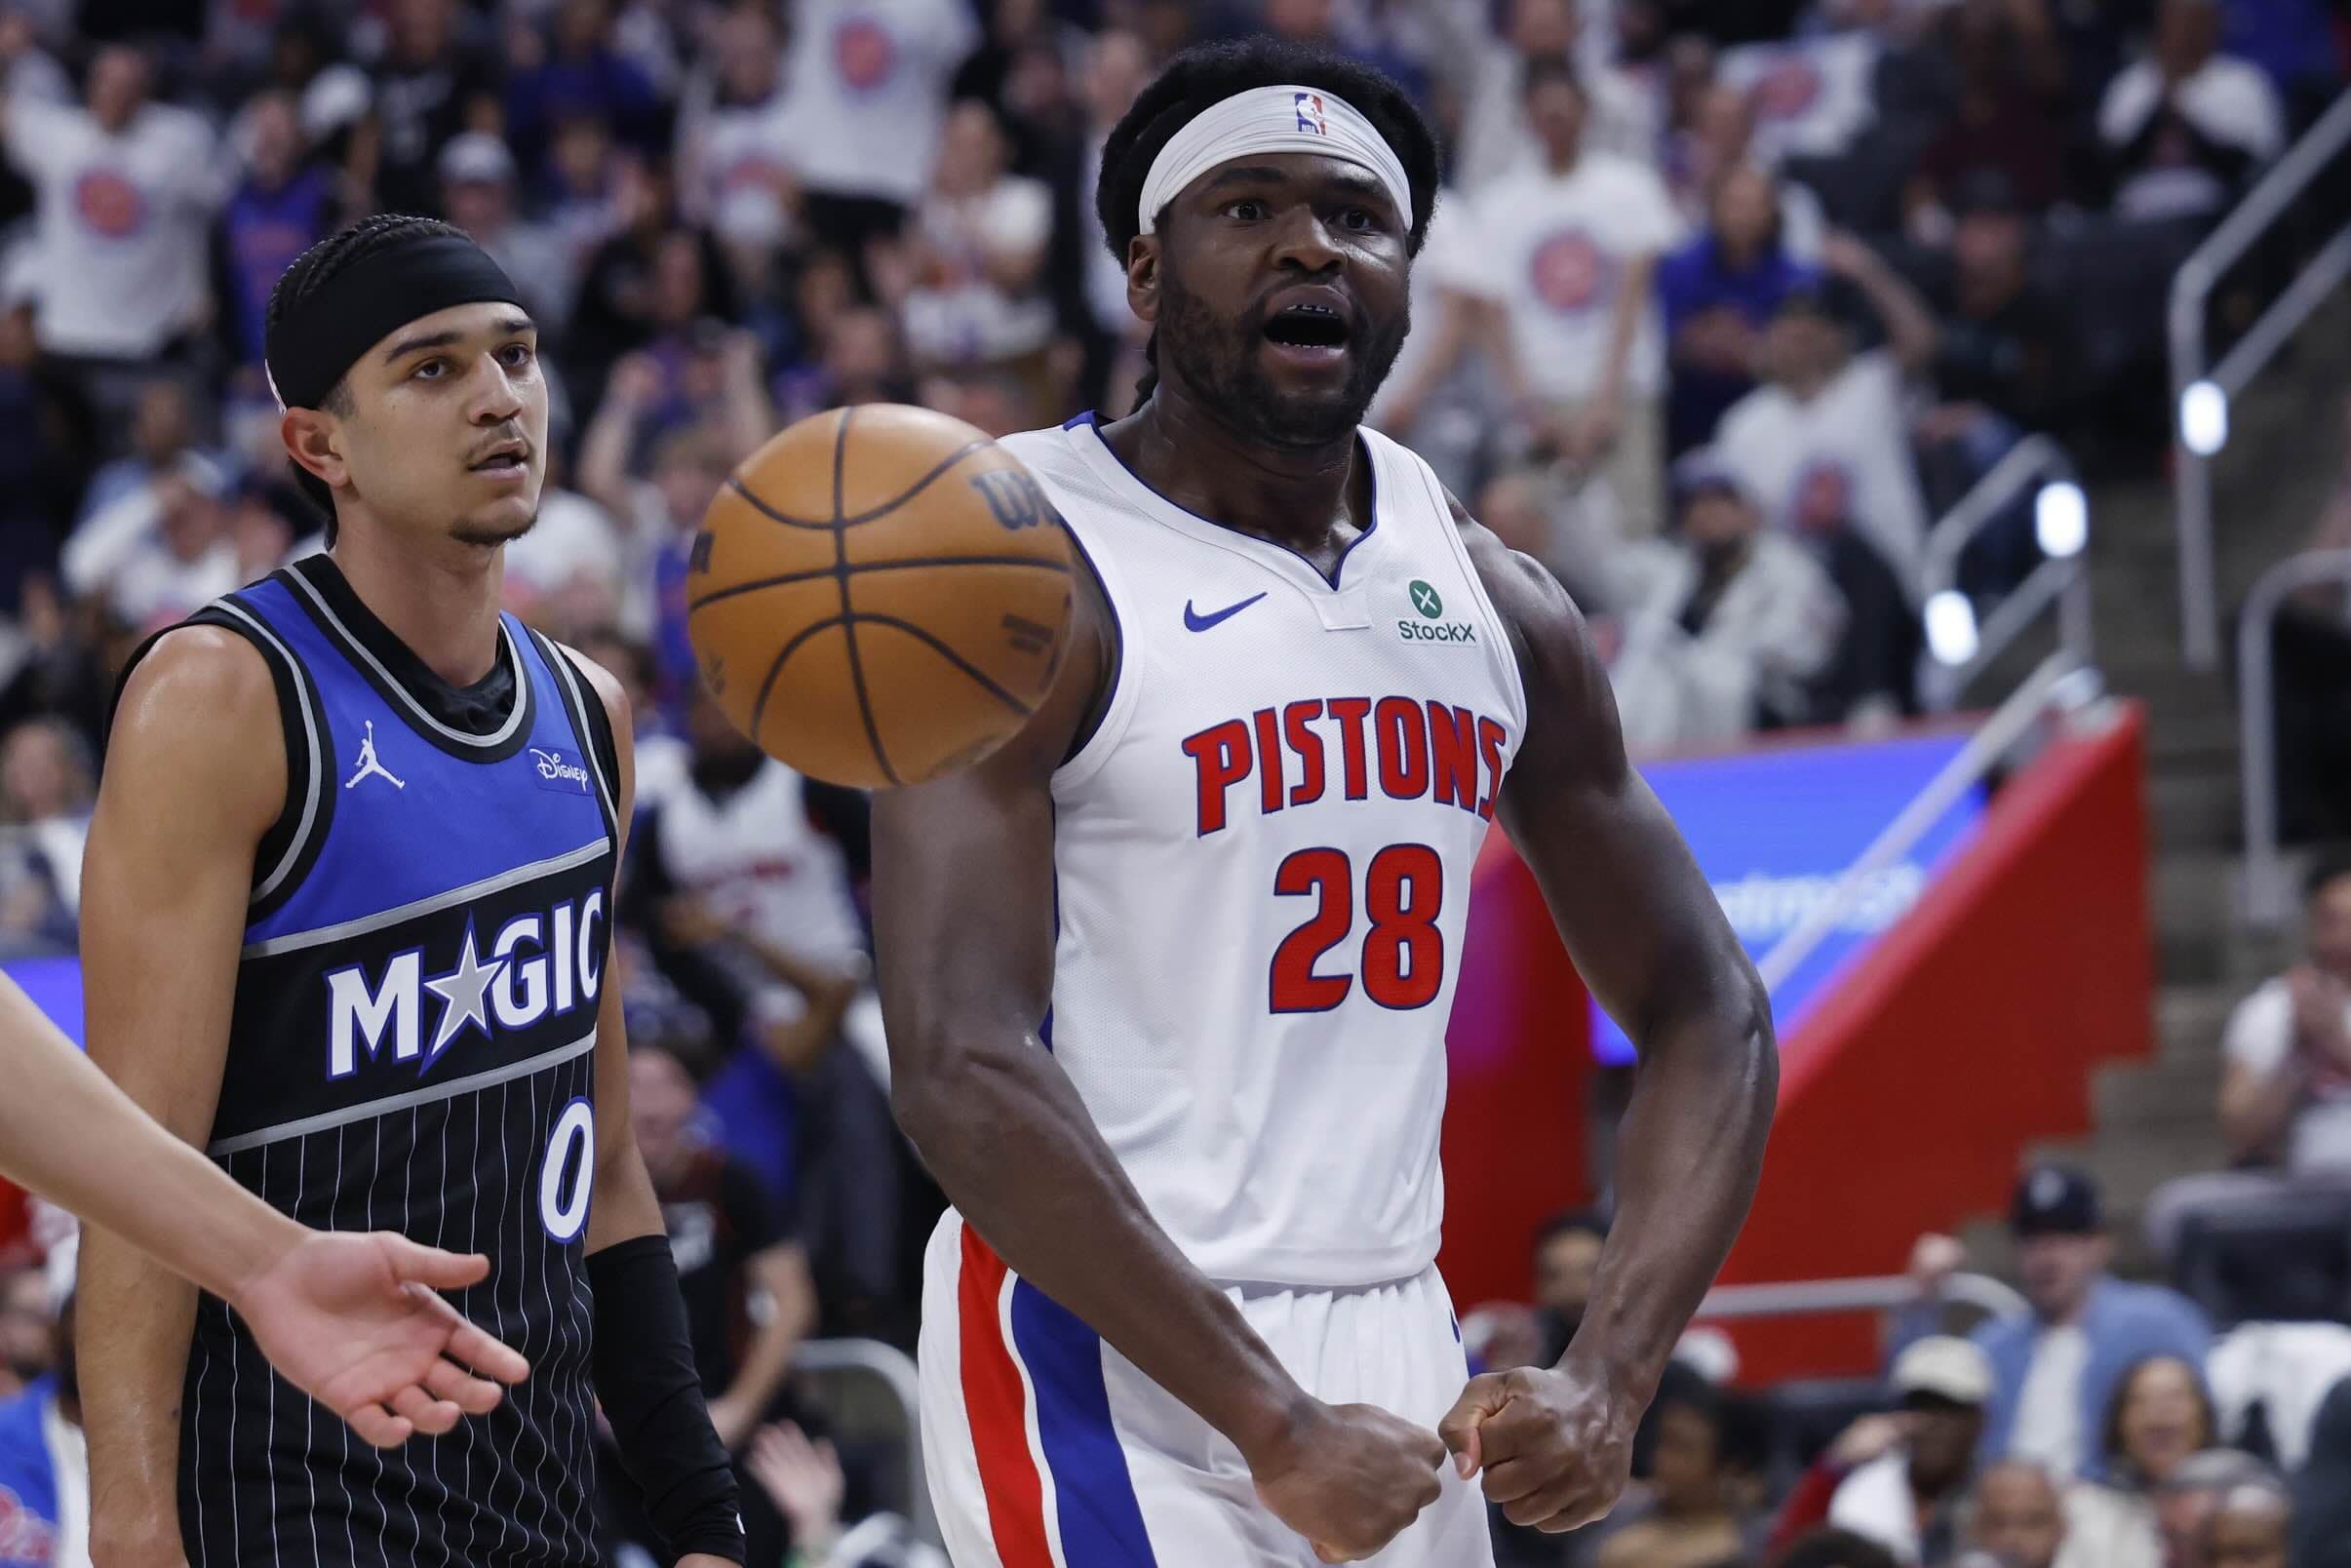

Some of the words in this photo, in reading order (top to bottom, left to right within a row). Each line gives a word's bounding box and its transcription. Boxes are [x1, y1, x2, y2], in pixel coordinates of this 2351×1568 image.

[1398, 620, 1476, 643] StockX
[1181, 695, 1507, 839] PISTONS
[1270, 843, 1444, 1014] 28
[538, 1096, 596, 1243] 0
